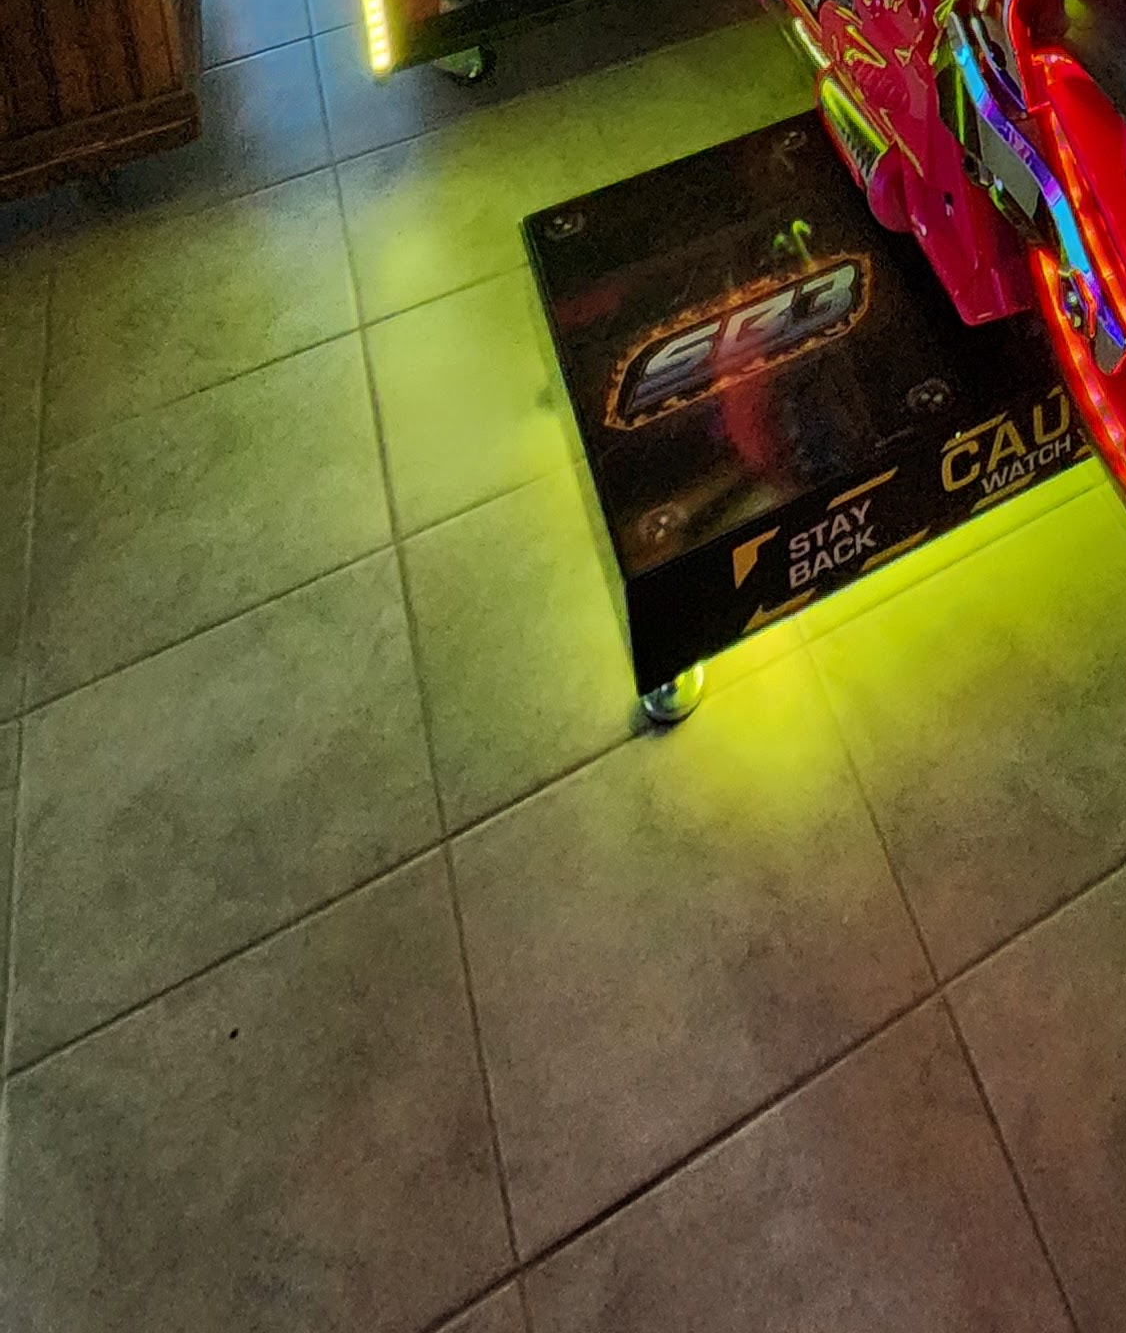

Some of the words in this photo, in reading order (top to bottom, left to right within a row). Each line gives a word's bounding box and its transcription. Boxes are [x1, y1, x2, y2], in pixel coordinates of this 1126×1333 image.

[980, 434, 1072, 495] WATCH
[788, 498, 872, 561] STAY
[788, 524, 879, 590] BACK
